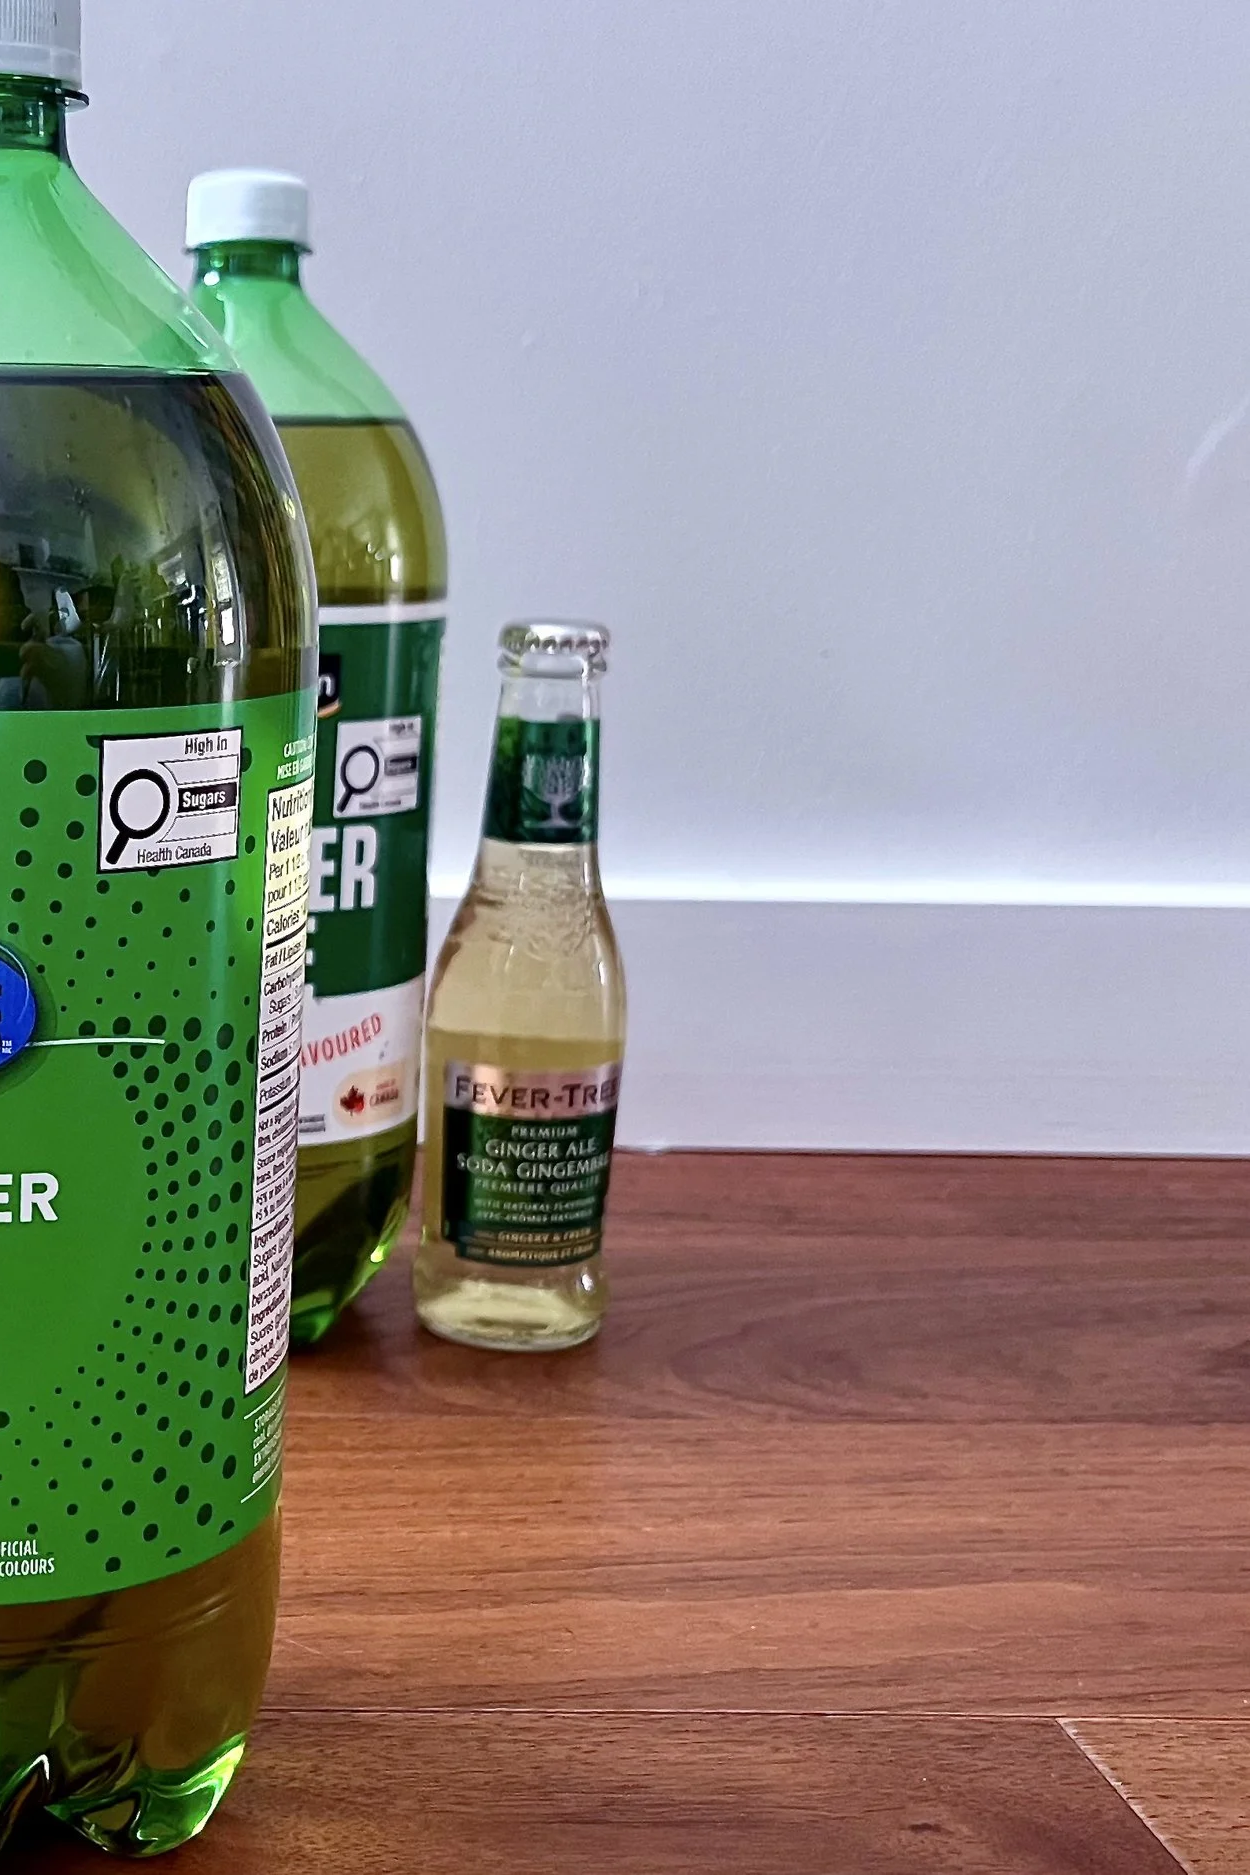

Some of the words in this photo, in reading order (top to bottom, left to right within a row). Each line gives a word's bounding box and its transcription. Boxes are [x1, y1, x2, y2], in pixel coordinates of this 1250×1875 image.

[185, 737, 213, 756] High
[182, 791, 226, 809] Sugars
[137, 846, 172, 864] Health
[175, 843, 212, 860] Canada
[511, 1125, 578, 1139] PREMIUM
[485, 1139, 560, 1160] GINGER
[565, 1136, 597, 1156] ALE
[456, 1153, 507, 1177] SODA
